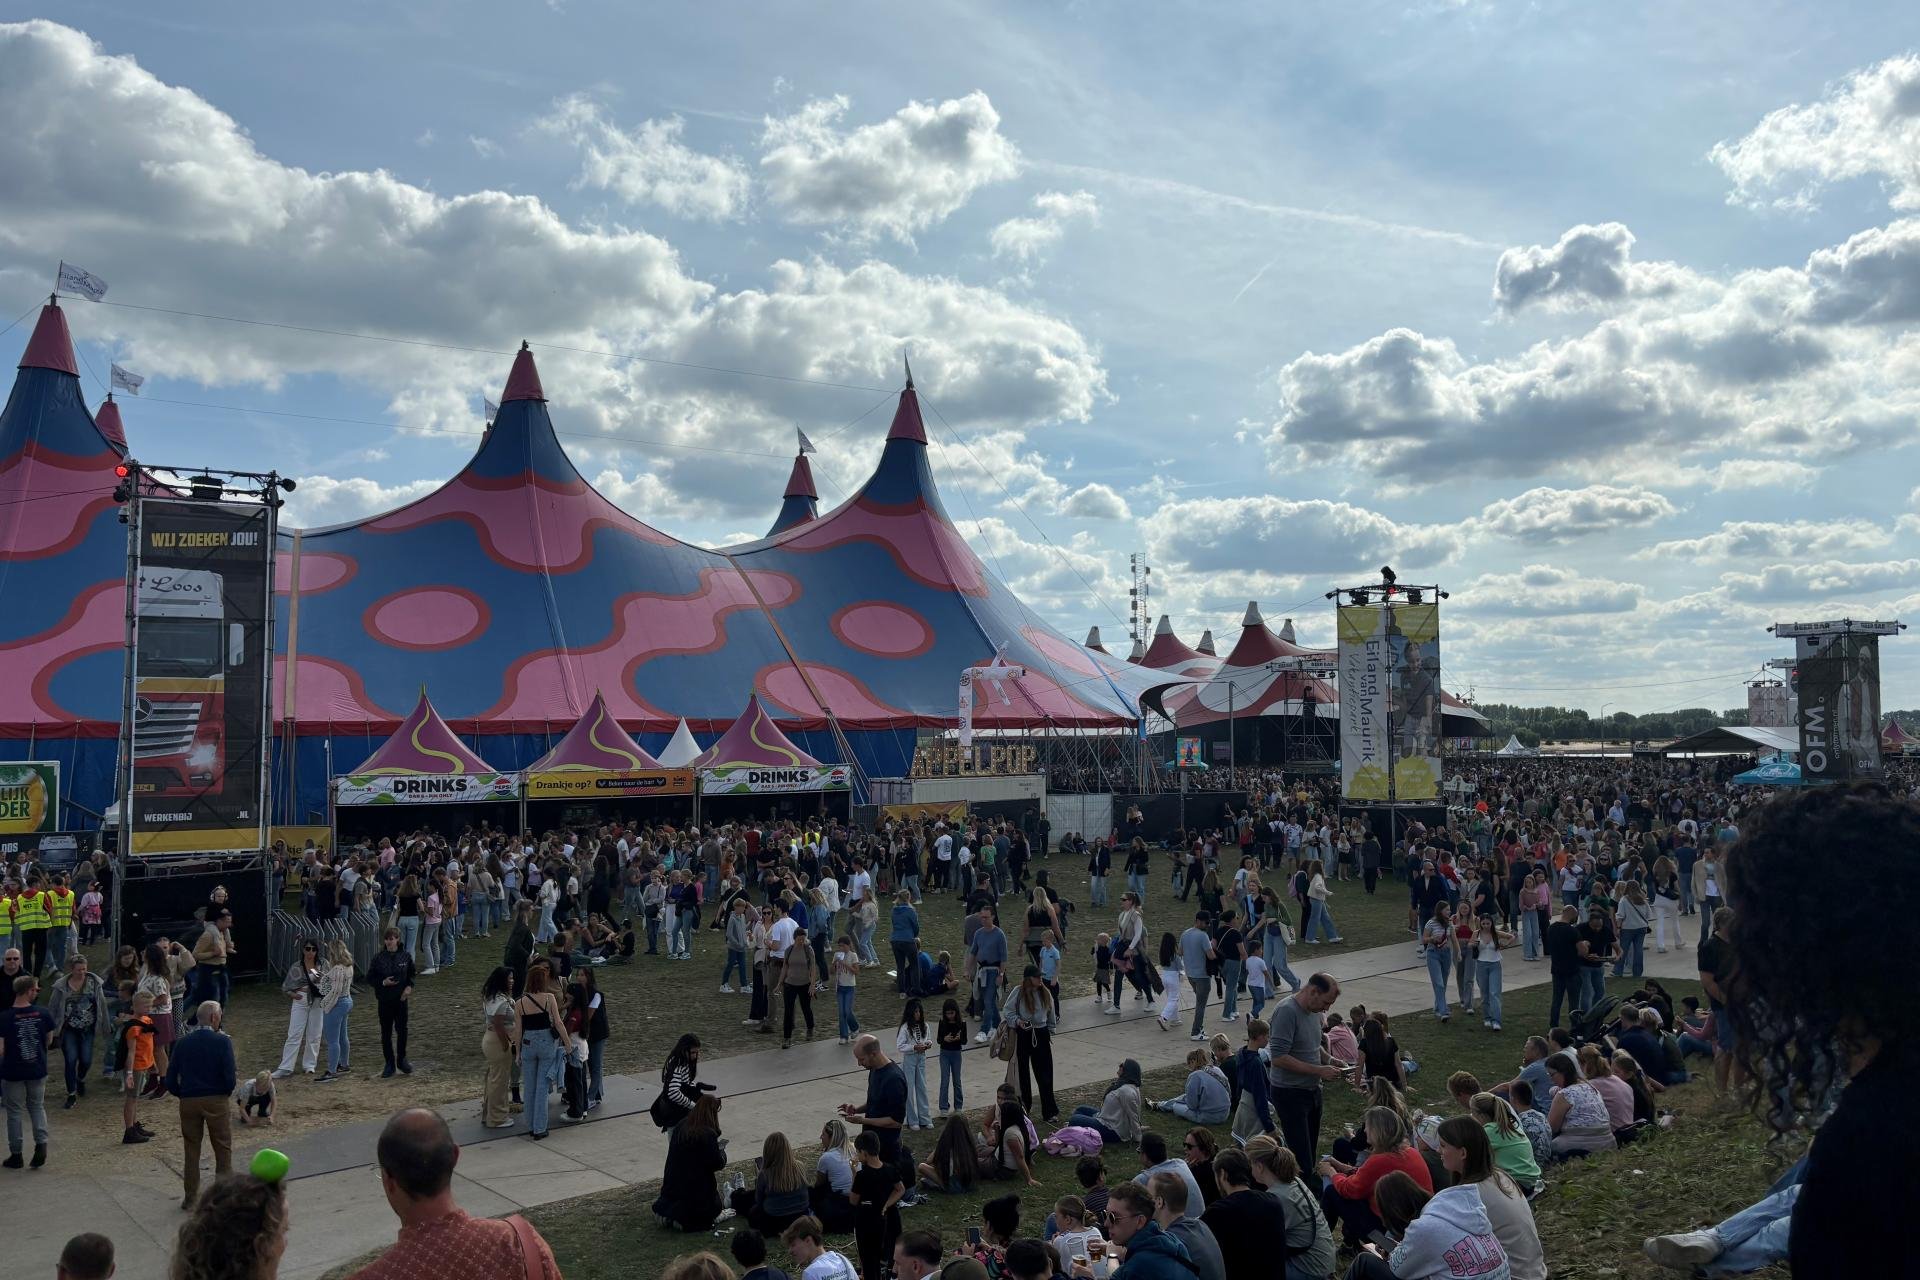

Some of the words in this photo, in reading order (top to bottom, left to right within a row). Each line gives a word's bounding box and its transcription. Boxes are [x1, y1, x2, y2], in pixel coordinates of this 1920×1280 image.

[151, 531, 176, 548] WIJ
[178, 531, 229, 548] ZOEKEN
[230, 531, 258, 547] JOU!
[150, 576, 203, 593] Loos
[1366, 640, 1381, 696] Eiland
[1359, 675, 1369, 697] van
[1359, 699, 1376, 764] Maurik
[536, 780, 573, 790] Drankje
[575, 779, 592, 789] op?
[748, 770, 809, 784] DRINKS
[1, 786, 30, 801] LIJK
[394, 778, 468, 794] DRINKS
[0, 801, 30, 817] DER
[144, 812, 193, 822] WERKENBIJ
[236, 810, 250, 820] .NL
